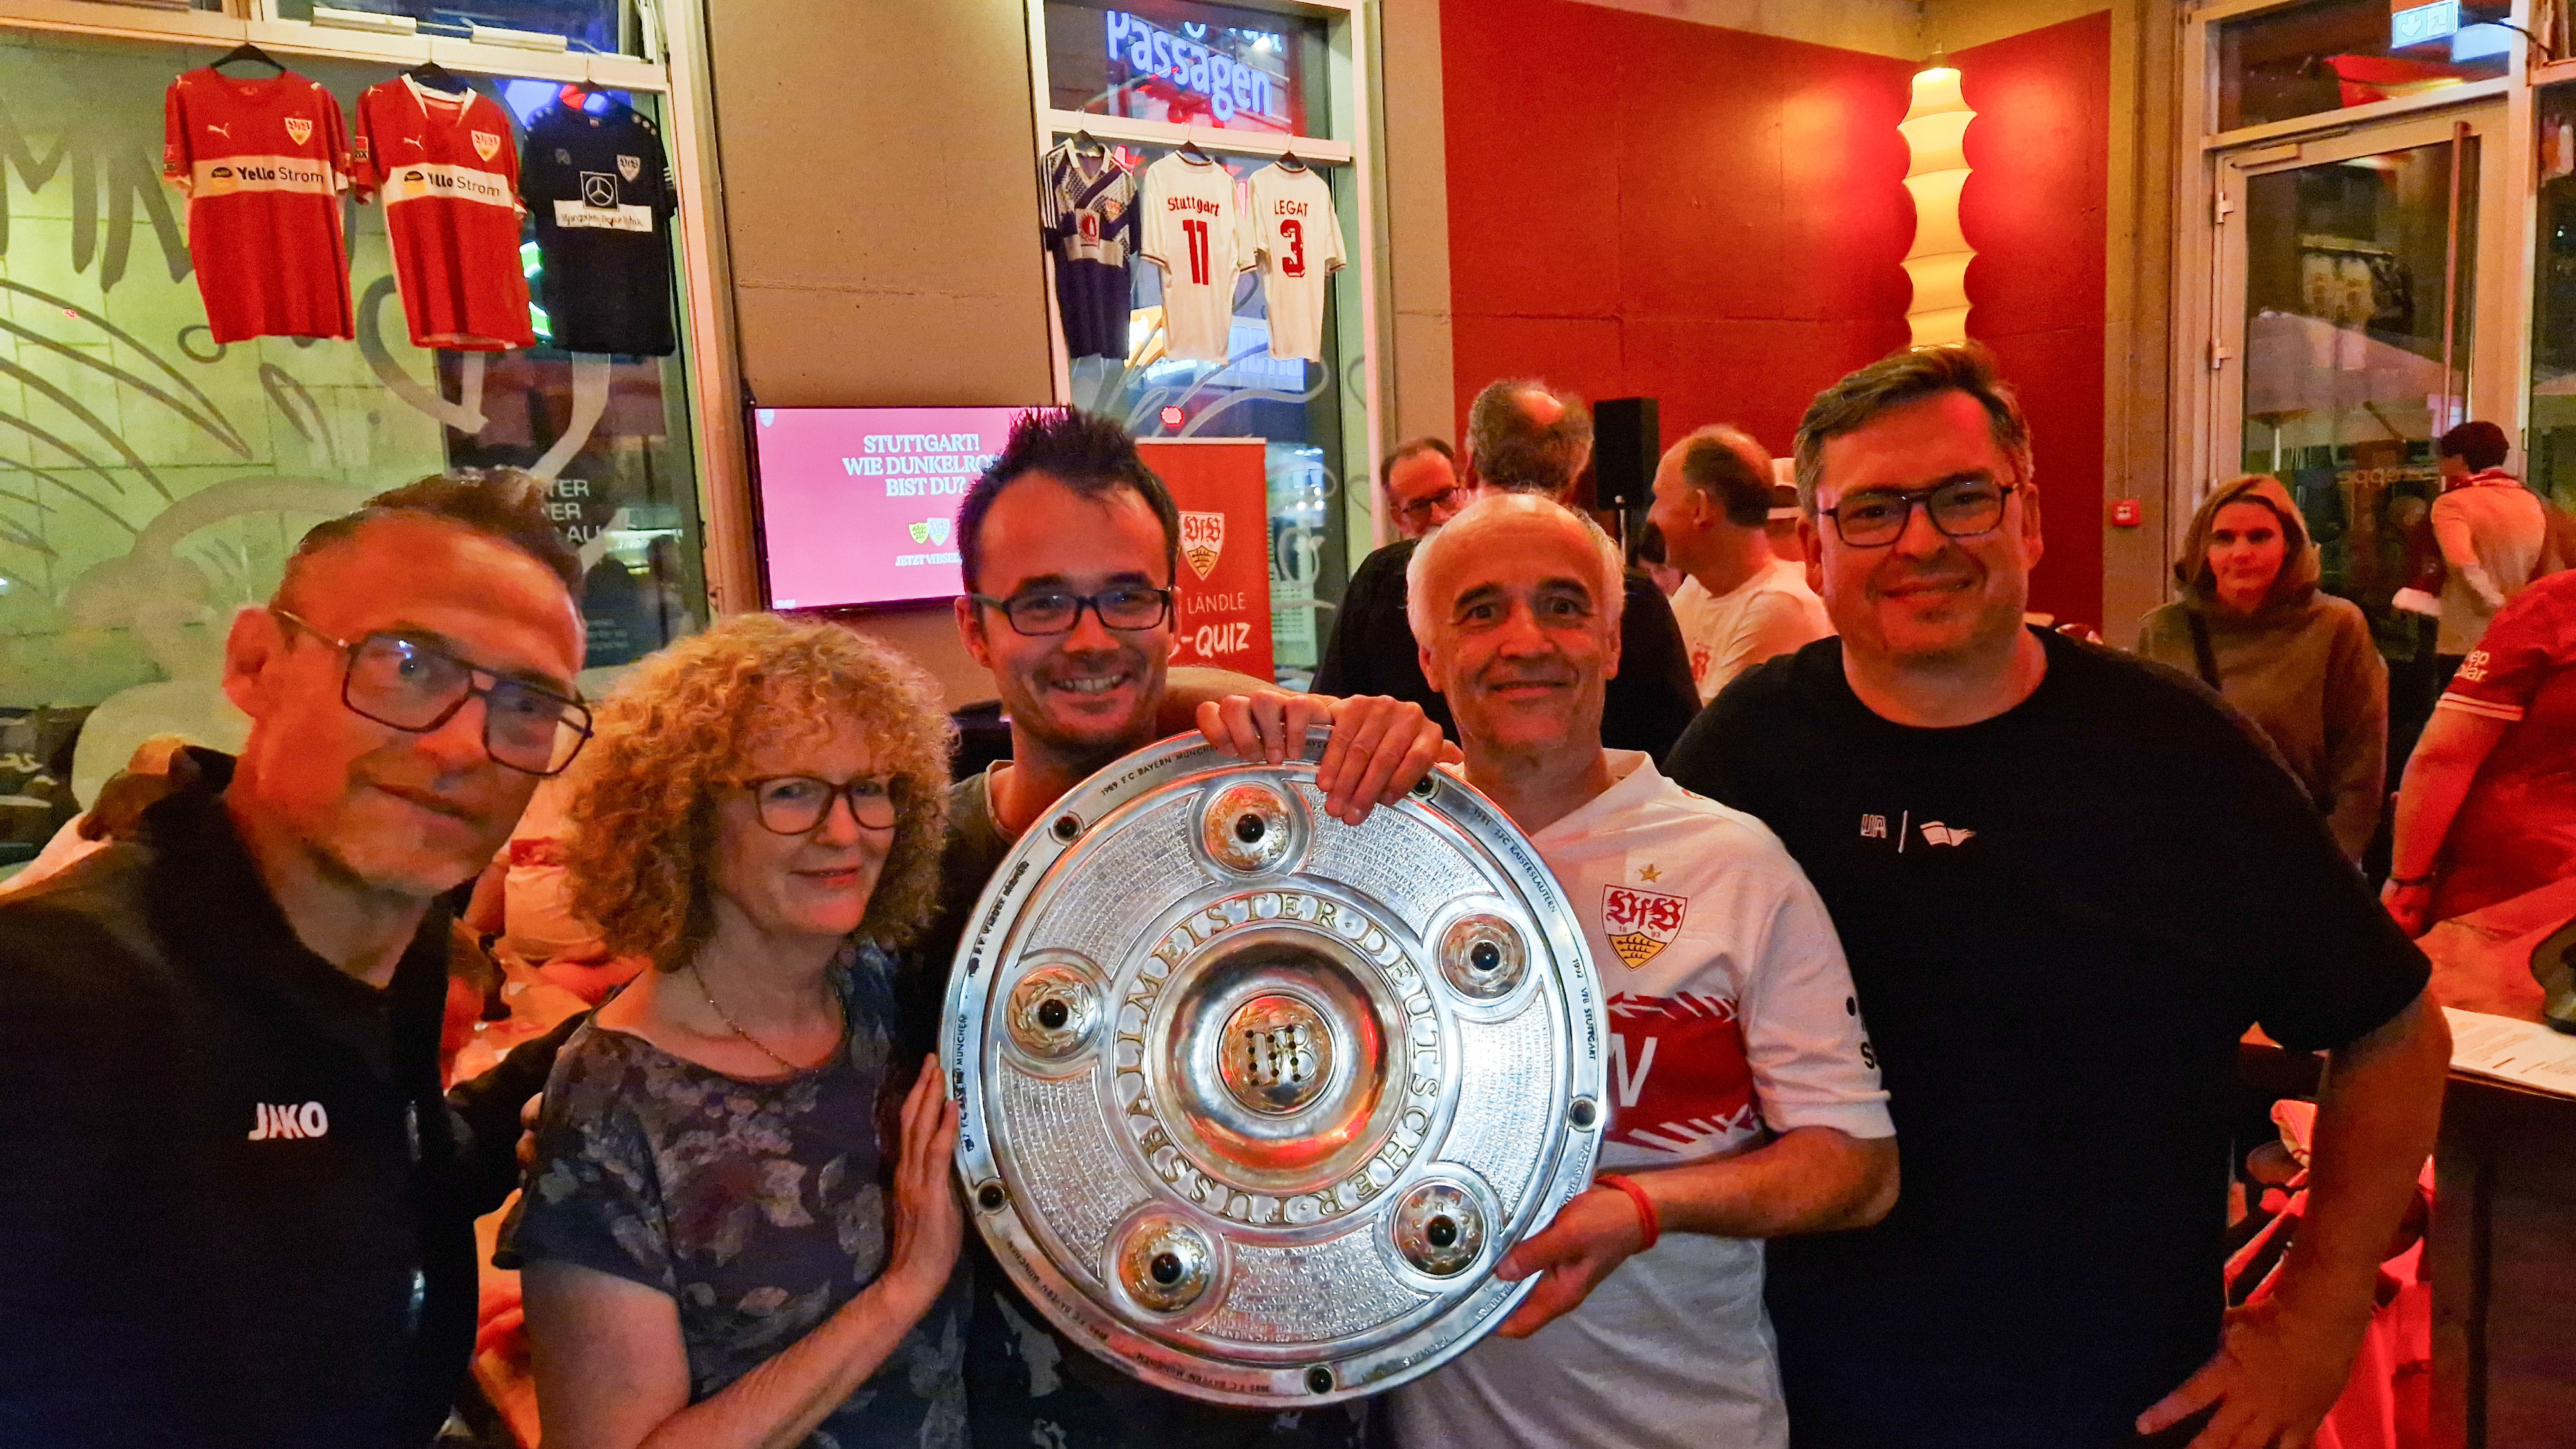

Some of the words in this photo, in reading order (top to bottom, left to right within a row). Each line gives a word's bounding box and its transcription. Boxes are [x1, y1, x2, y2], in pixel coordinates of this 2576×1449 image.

[236, 166, 275, 181] Yello
[279, 167, 323, 183] Strom
[457, 176, 500, 196] Strom
[1167, 197, 1220, 217] Stuttgart
[1274, 199, 1308, 218] LEGAT
[1182, 219, 1209, 286] 11
[1280, 219, 1305, 278] 3
[864, 433, 981, 453] STUTTGART!
[842, 456, 884, 476] WIE
[886, 477, 927, 497] BIST
[929, 475, 967, 496] DU?
[895, 554, 925, 567] JETZT
[1187, 591, 1246, 614] LÄNDLE
[1168, 621, 1251, 659] -QUIZ
[1135, 753, 1171, 775] BAYERN
[1508, 843, 1560, 913] KAISERSLAUTERN
[1573, 957, 1586, 978] 1992
[1585, 1007, 1597, 1059] STUTTGART
[247, 1101, 328, 1141] JAKO
